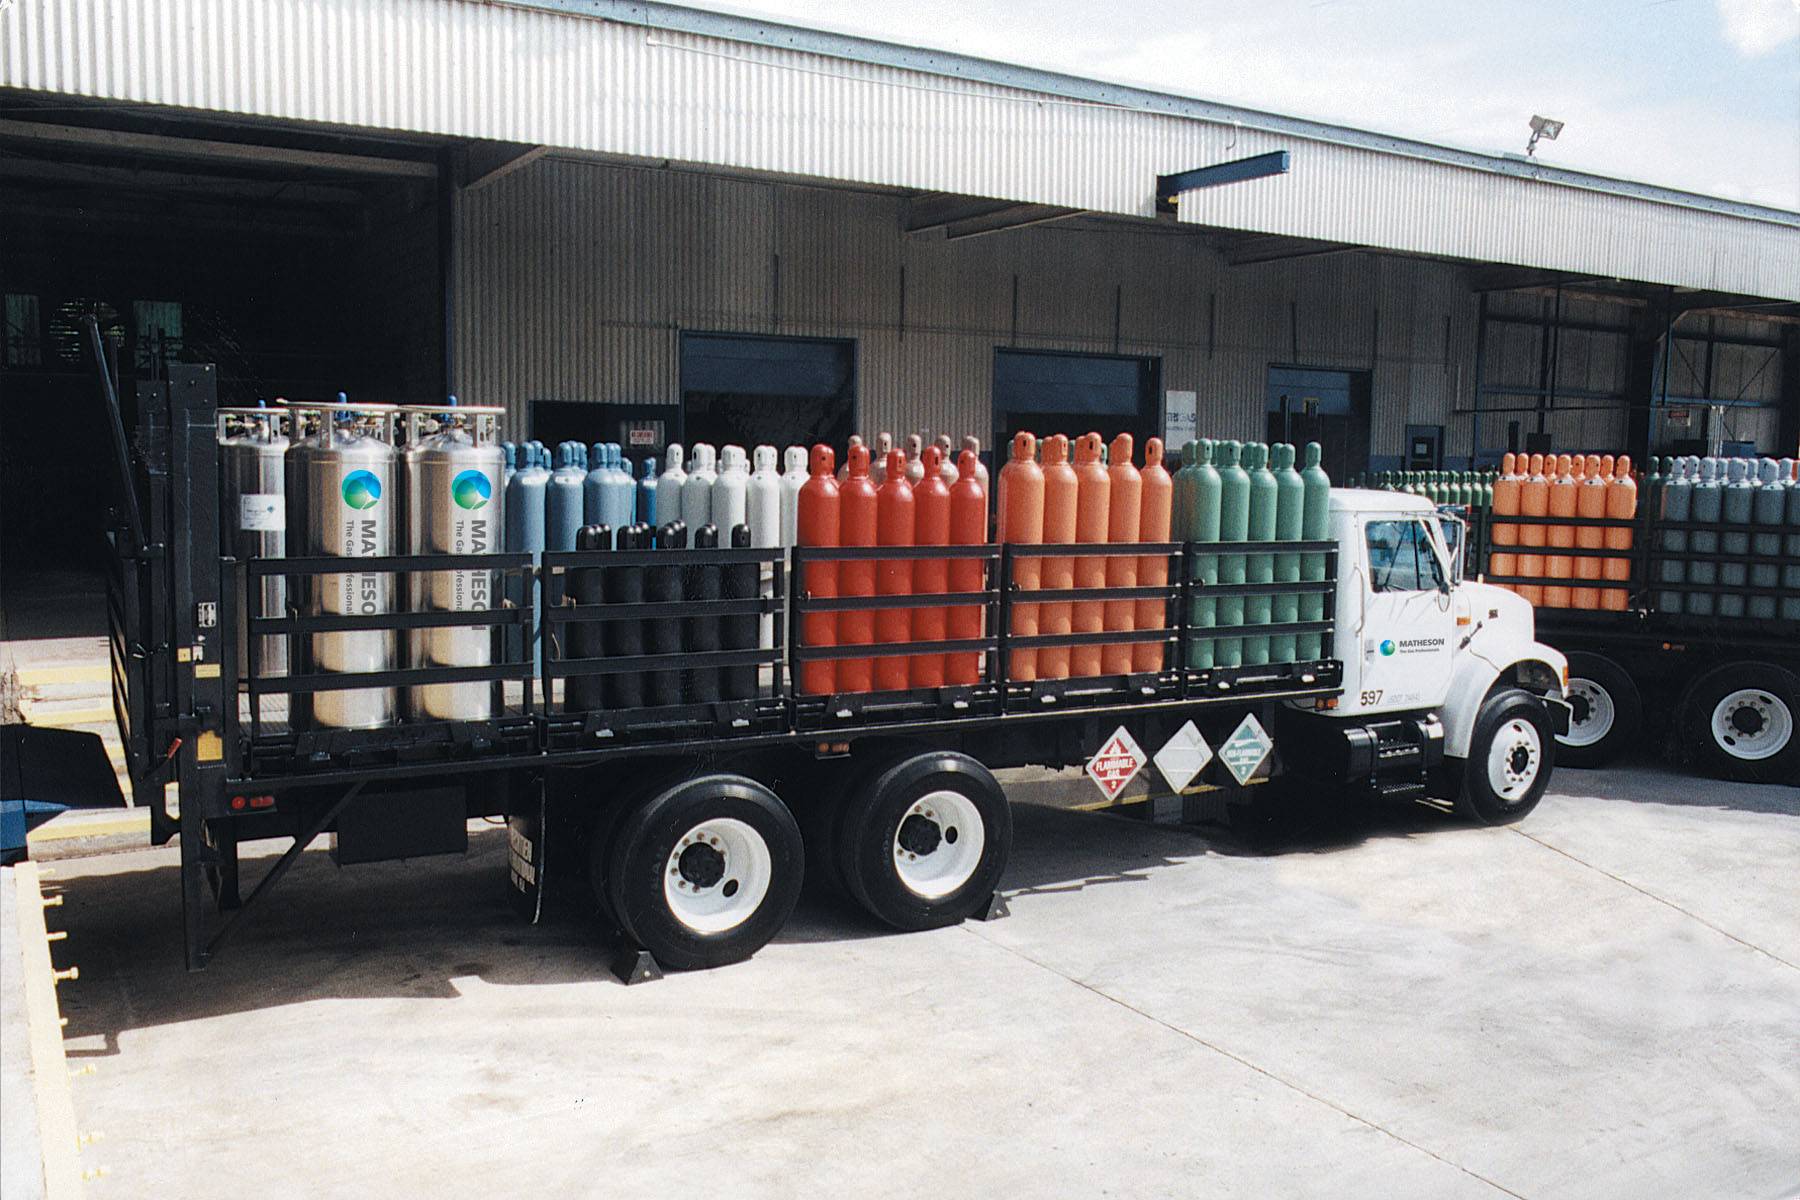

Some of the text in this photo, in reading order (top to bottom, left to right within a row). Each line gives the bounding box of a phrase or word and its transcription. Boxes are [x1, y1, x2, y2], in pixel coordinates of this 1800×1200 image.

[346, 520, 354, 537] The
[456, 521, 464, 537] The
[456, 540, 464, 555] Ga
[361, 520, 376, 614] MAESO
[1399, 638, 1445, 648] MATHESON
[1360, 690, 1383, 706] 597
[1095, 758, 1134, 772] FLAMMABLE
[1107, 769, 1120, 778] GAS
[1111, 780, 1117, 790] 2
